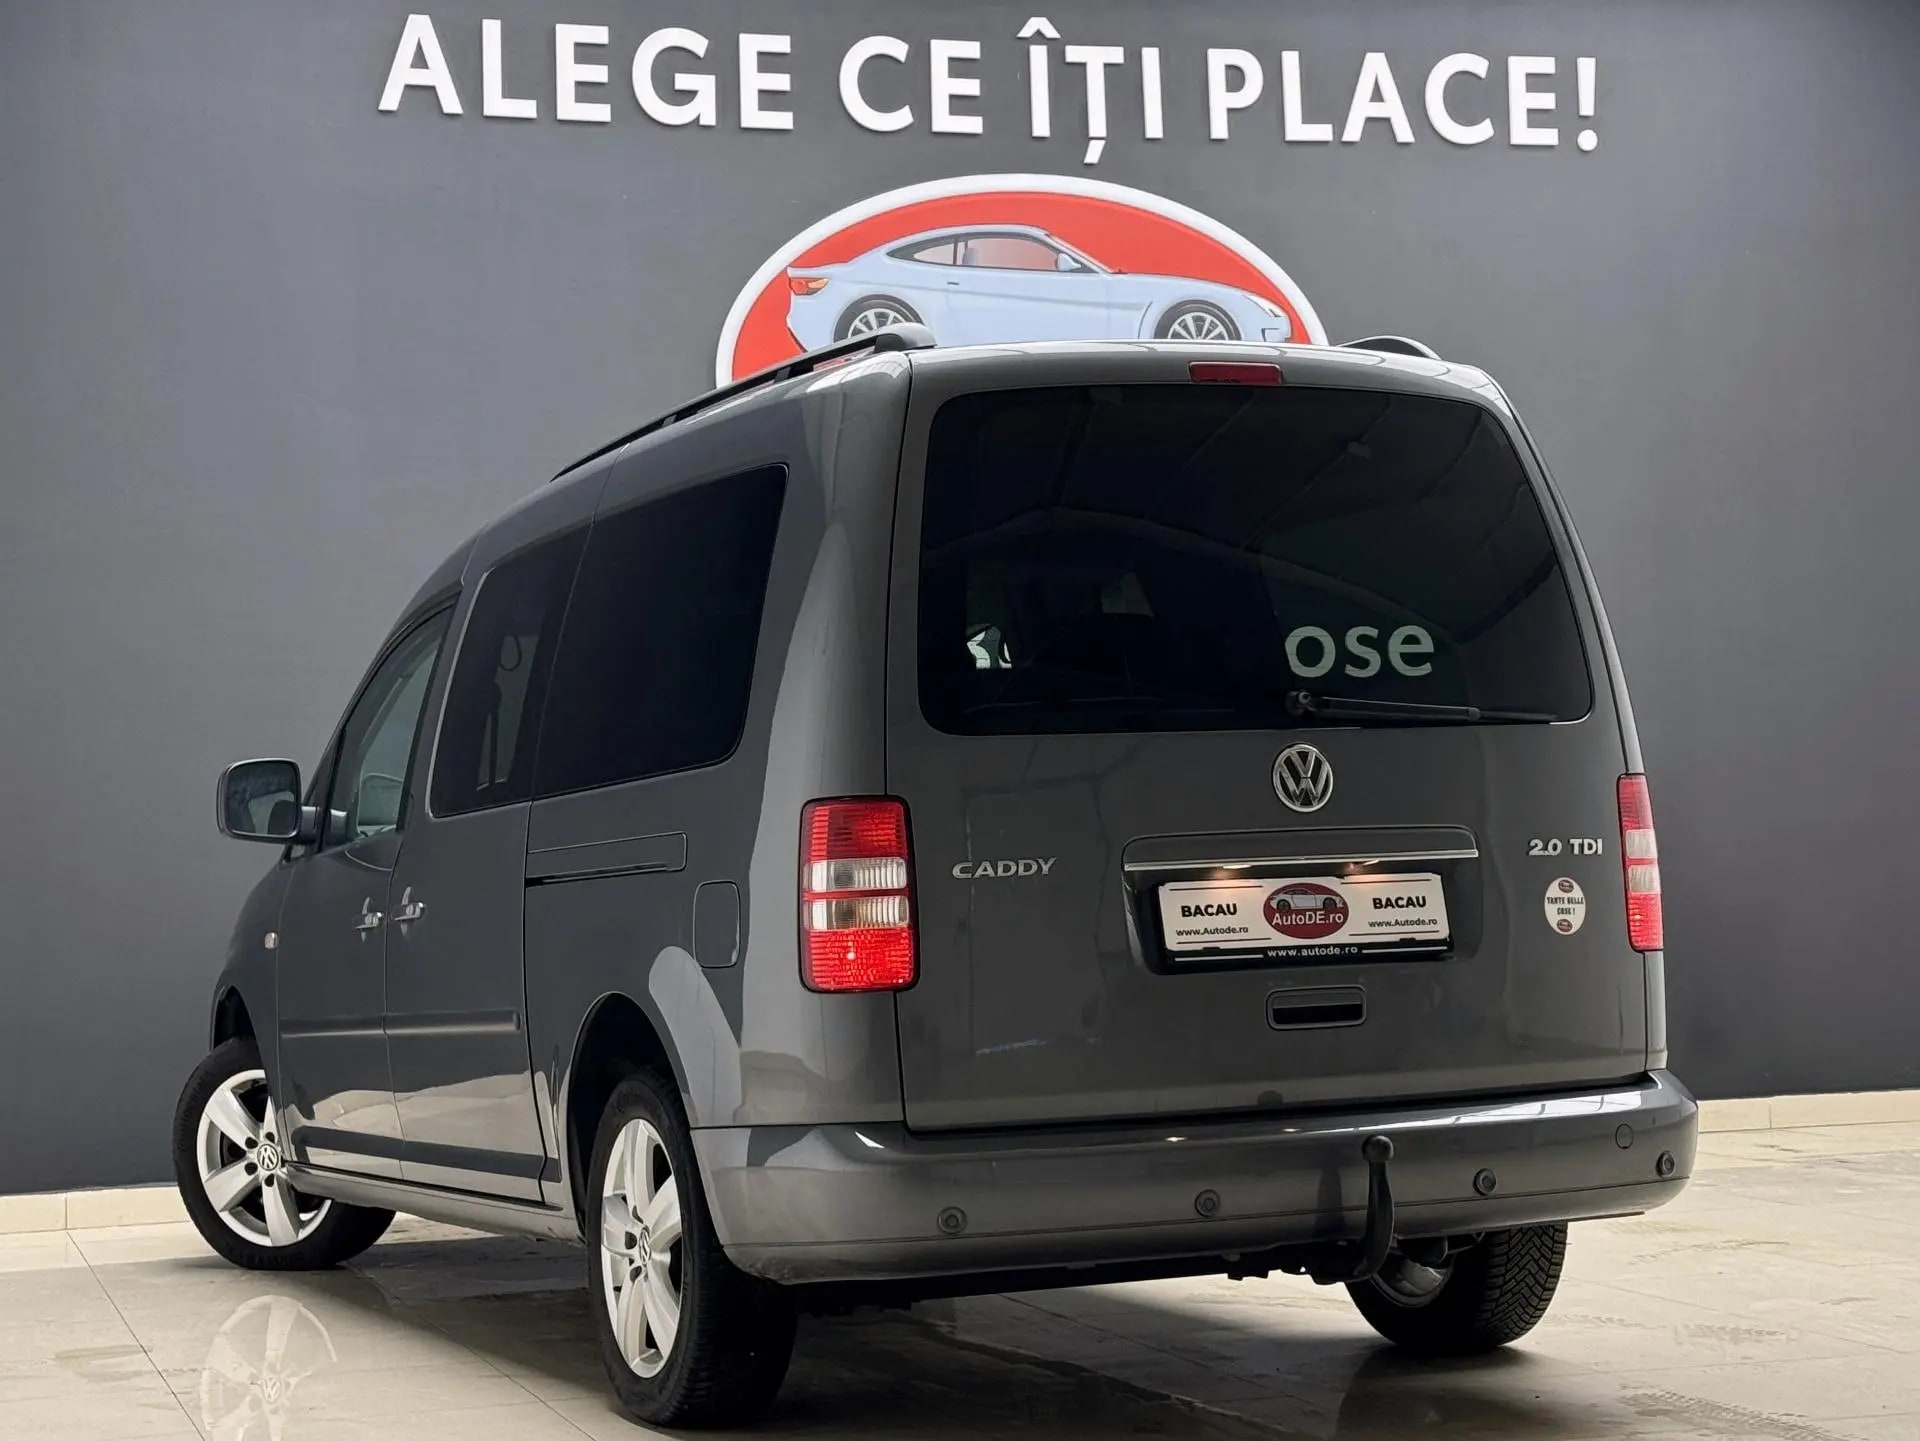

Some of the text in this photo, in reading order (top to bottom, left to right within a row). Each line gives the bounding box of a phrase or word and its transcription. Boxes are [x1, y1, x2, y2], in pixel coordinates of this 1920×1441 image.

[378, 13, 794, 131] ALEGE
[838, 35, 984, 135] CE
[1206, 48, 1599, 153] PLACE!
[1569, 838, 1603, 856] TDI
[952, 857, 1057, 879] CADDY
[1180, 903, 1238, 918] BACAU
[1372, 896, 1427, 910] BACAU
[1271, 911, 1345, 926] AutoDE.ro
[1368, 918, 1438, 928] www.Autode.ro
[1176, 926, 1249, 937] www.Autode.ro
[1267, 946, 1359, 958] www.autode.ro
